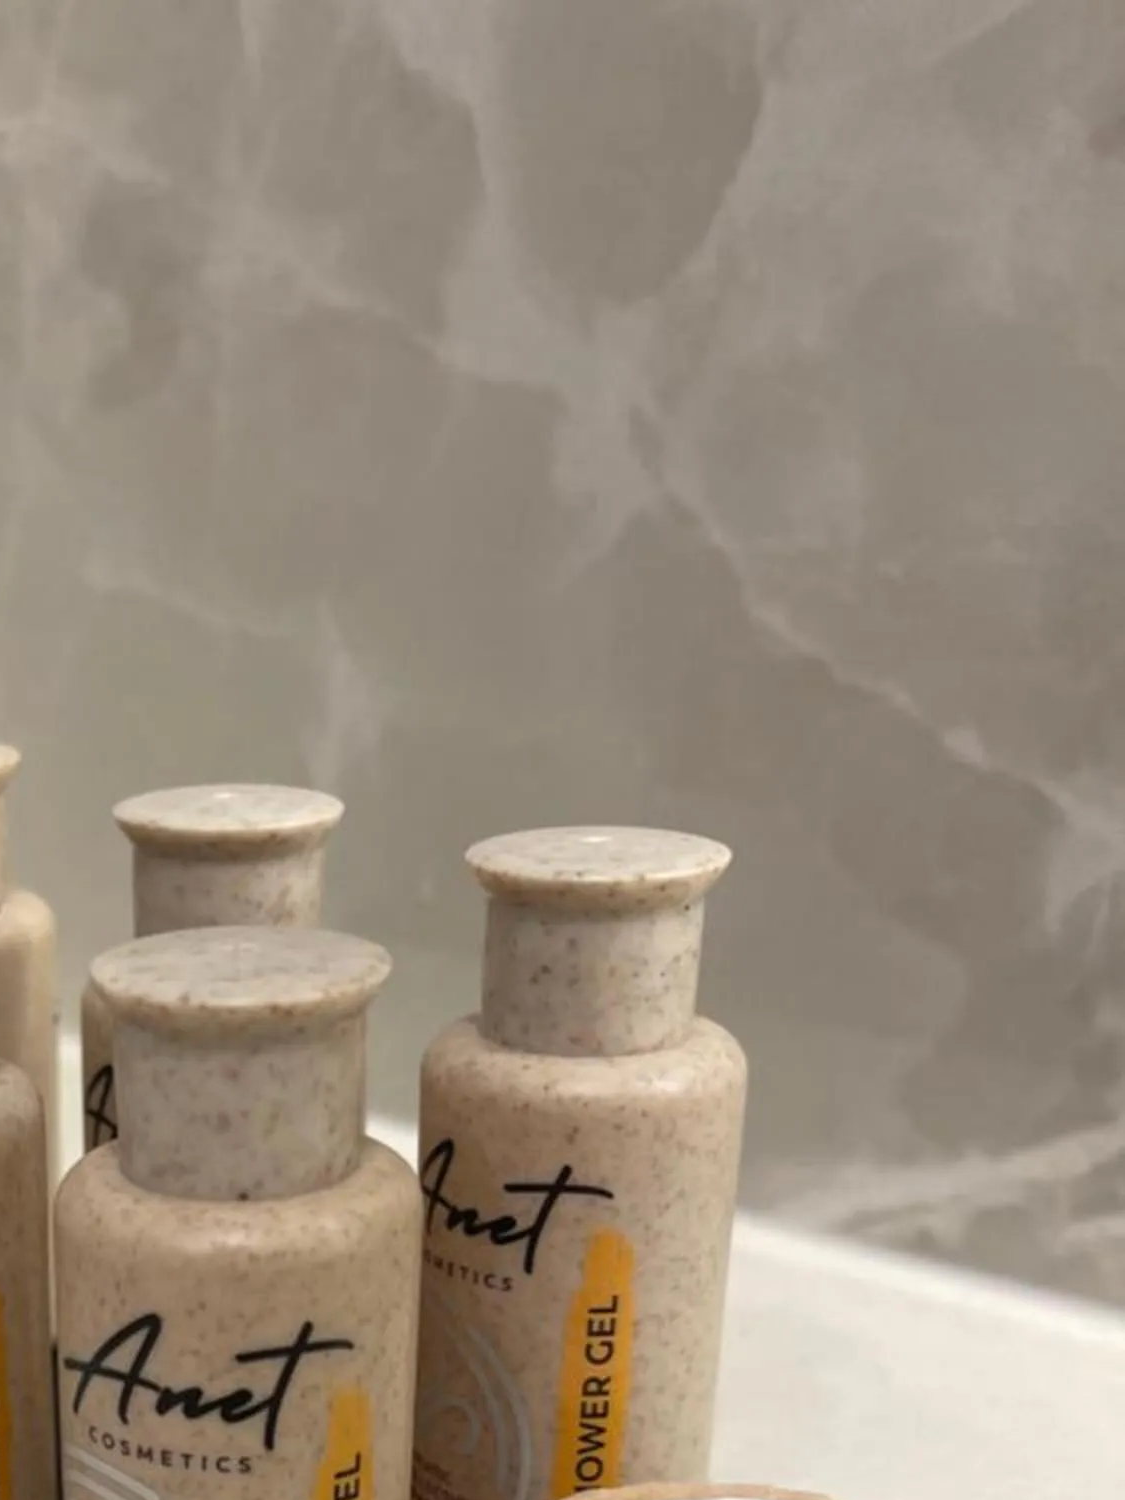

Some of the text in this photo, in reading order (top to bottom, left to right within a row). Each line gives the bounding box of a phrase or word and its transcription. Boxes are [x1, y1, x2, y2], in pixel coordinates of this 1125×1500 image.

[584, 1295, 620, 1366] GEL
[63, 1313, 353, 1451] Anet
[88, 1425, 253, 1474] COSMETICS
